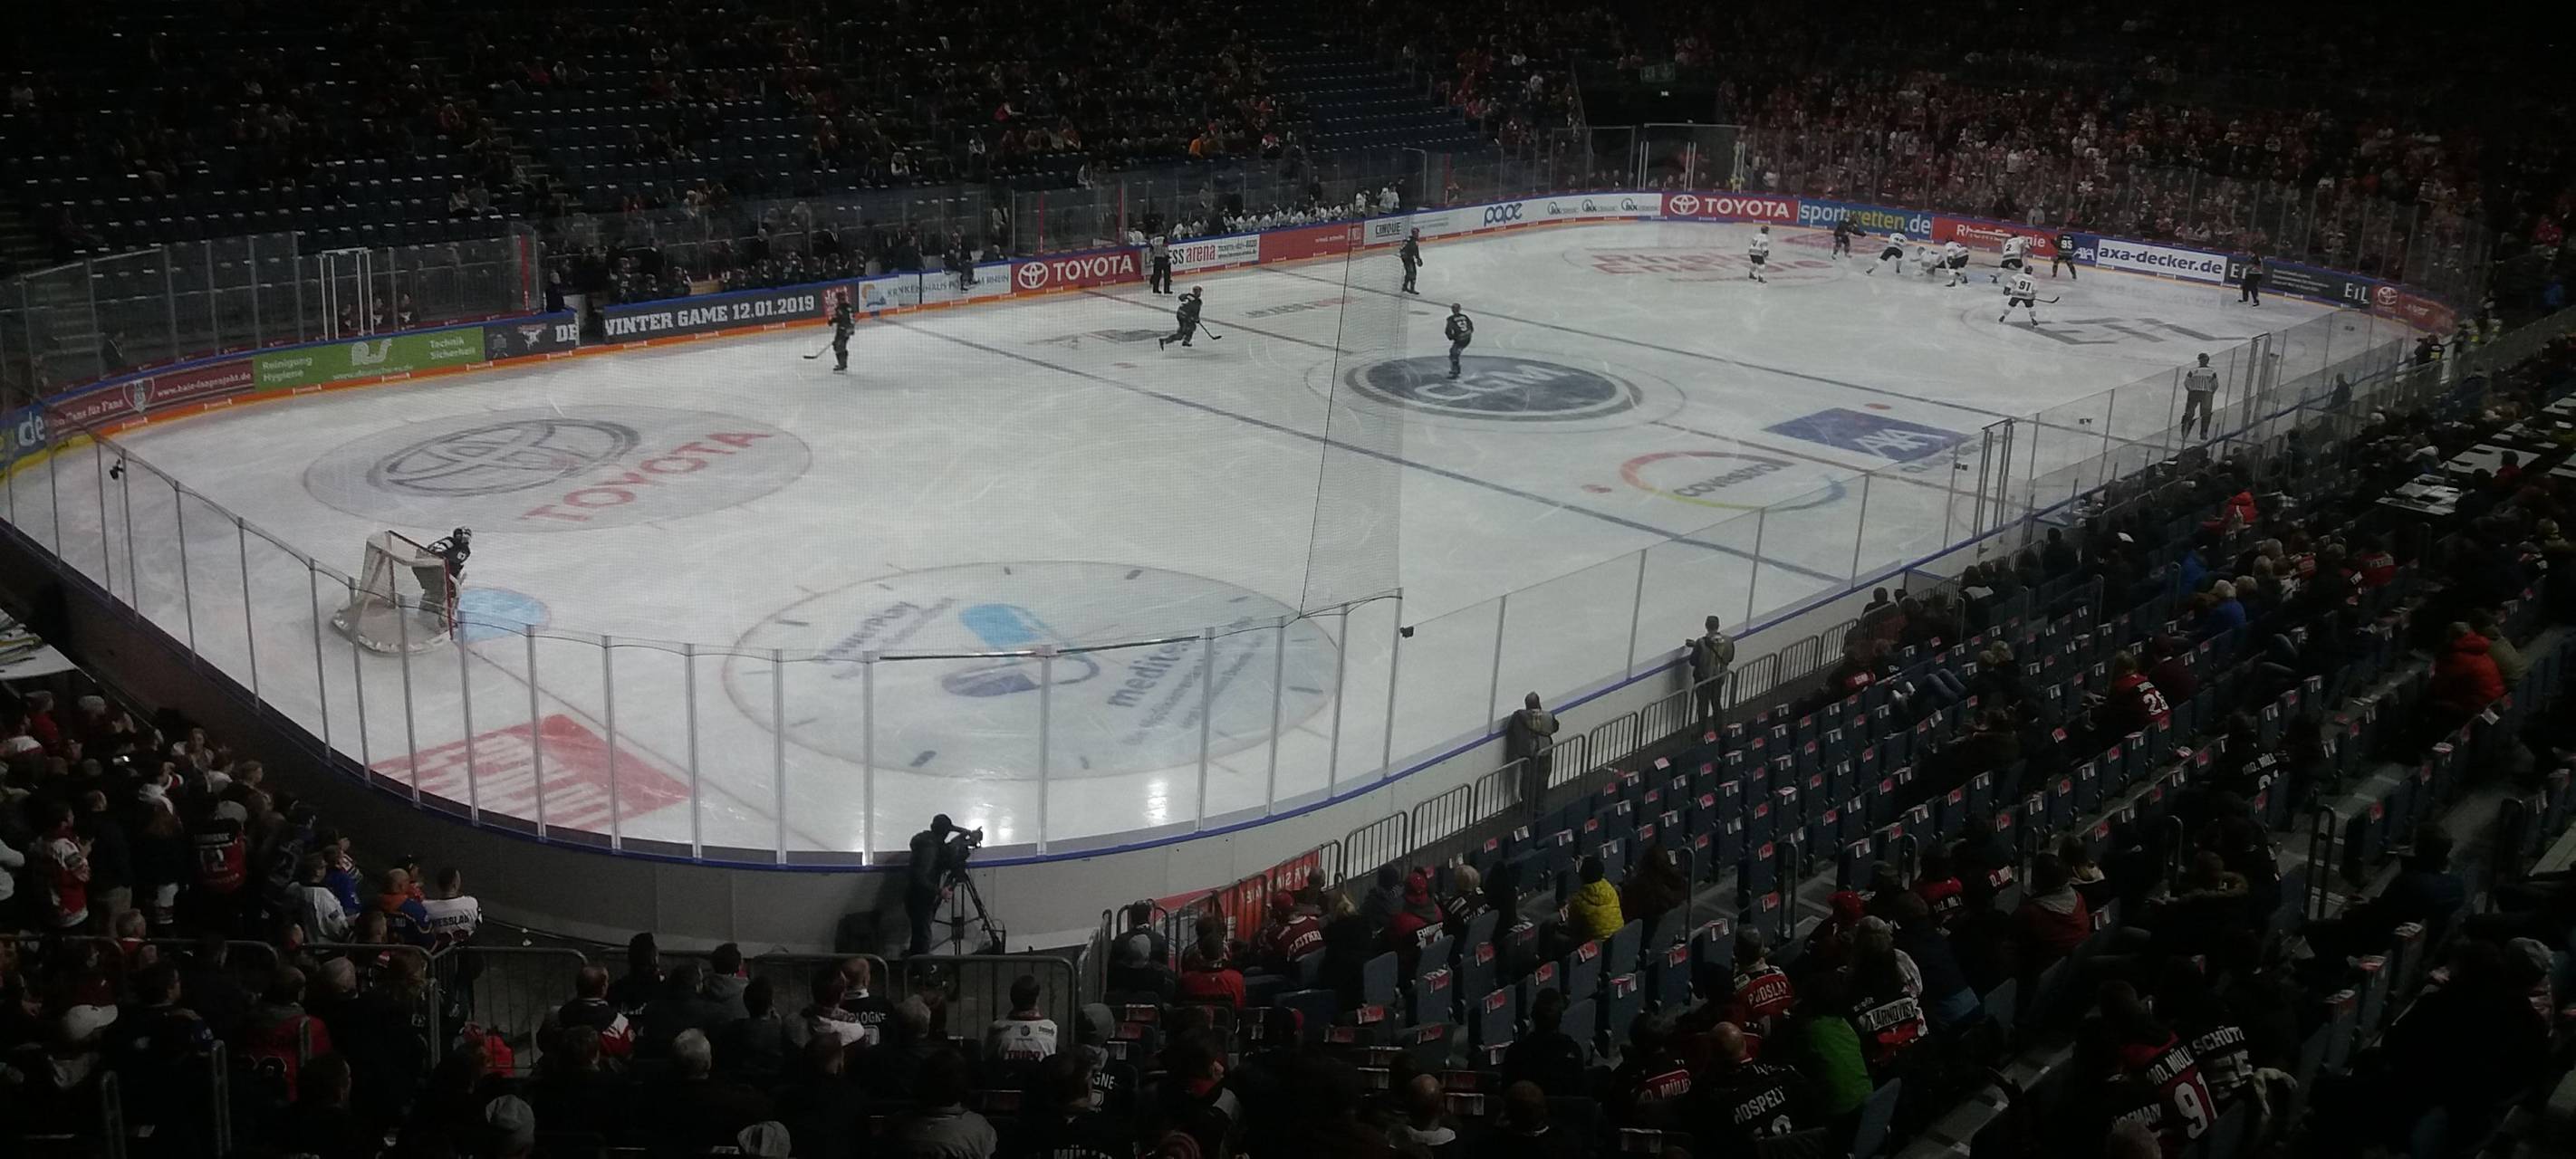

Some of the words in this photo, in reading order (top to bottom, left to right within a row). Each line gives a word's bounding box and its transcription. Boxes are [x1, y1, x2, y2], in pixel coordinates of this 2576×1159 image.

[1705, 197, 1790, 219] TOYOTA
[1956, 224, 2045, 249] RheinEgie
[2060, 238, 2073, 250] 95
[1186, 244, 1216, 263] arena
[2005, 244, 2013, 252] 2
[2072, 246, 2096, 261] AXA
[1053, 254, 1133, 281] TOYOTA
[2100, 244, 2223, 274] axa-decker.de
[2018, 281, 2032, 292] 91
[678, 305, 728, 327] GAME
[732, 294, 815, 321] 12.01.2019
[429, 336, 465, 349] Technik
[555, 323, 576, 343] DE
[430, 346, 476, 360] Sicherheit
[262, 356, 312, 371] Reinigung
[262, 369, 304, 383] Hygiene
[101, 398, 123, 413] Fans
[519, 431, 774, 522] TOYOTA
[2165, 1045, 2196, 1075] MÜLL
[2174, 1071, 2218, 1140] 91
